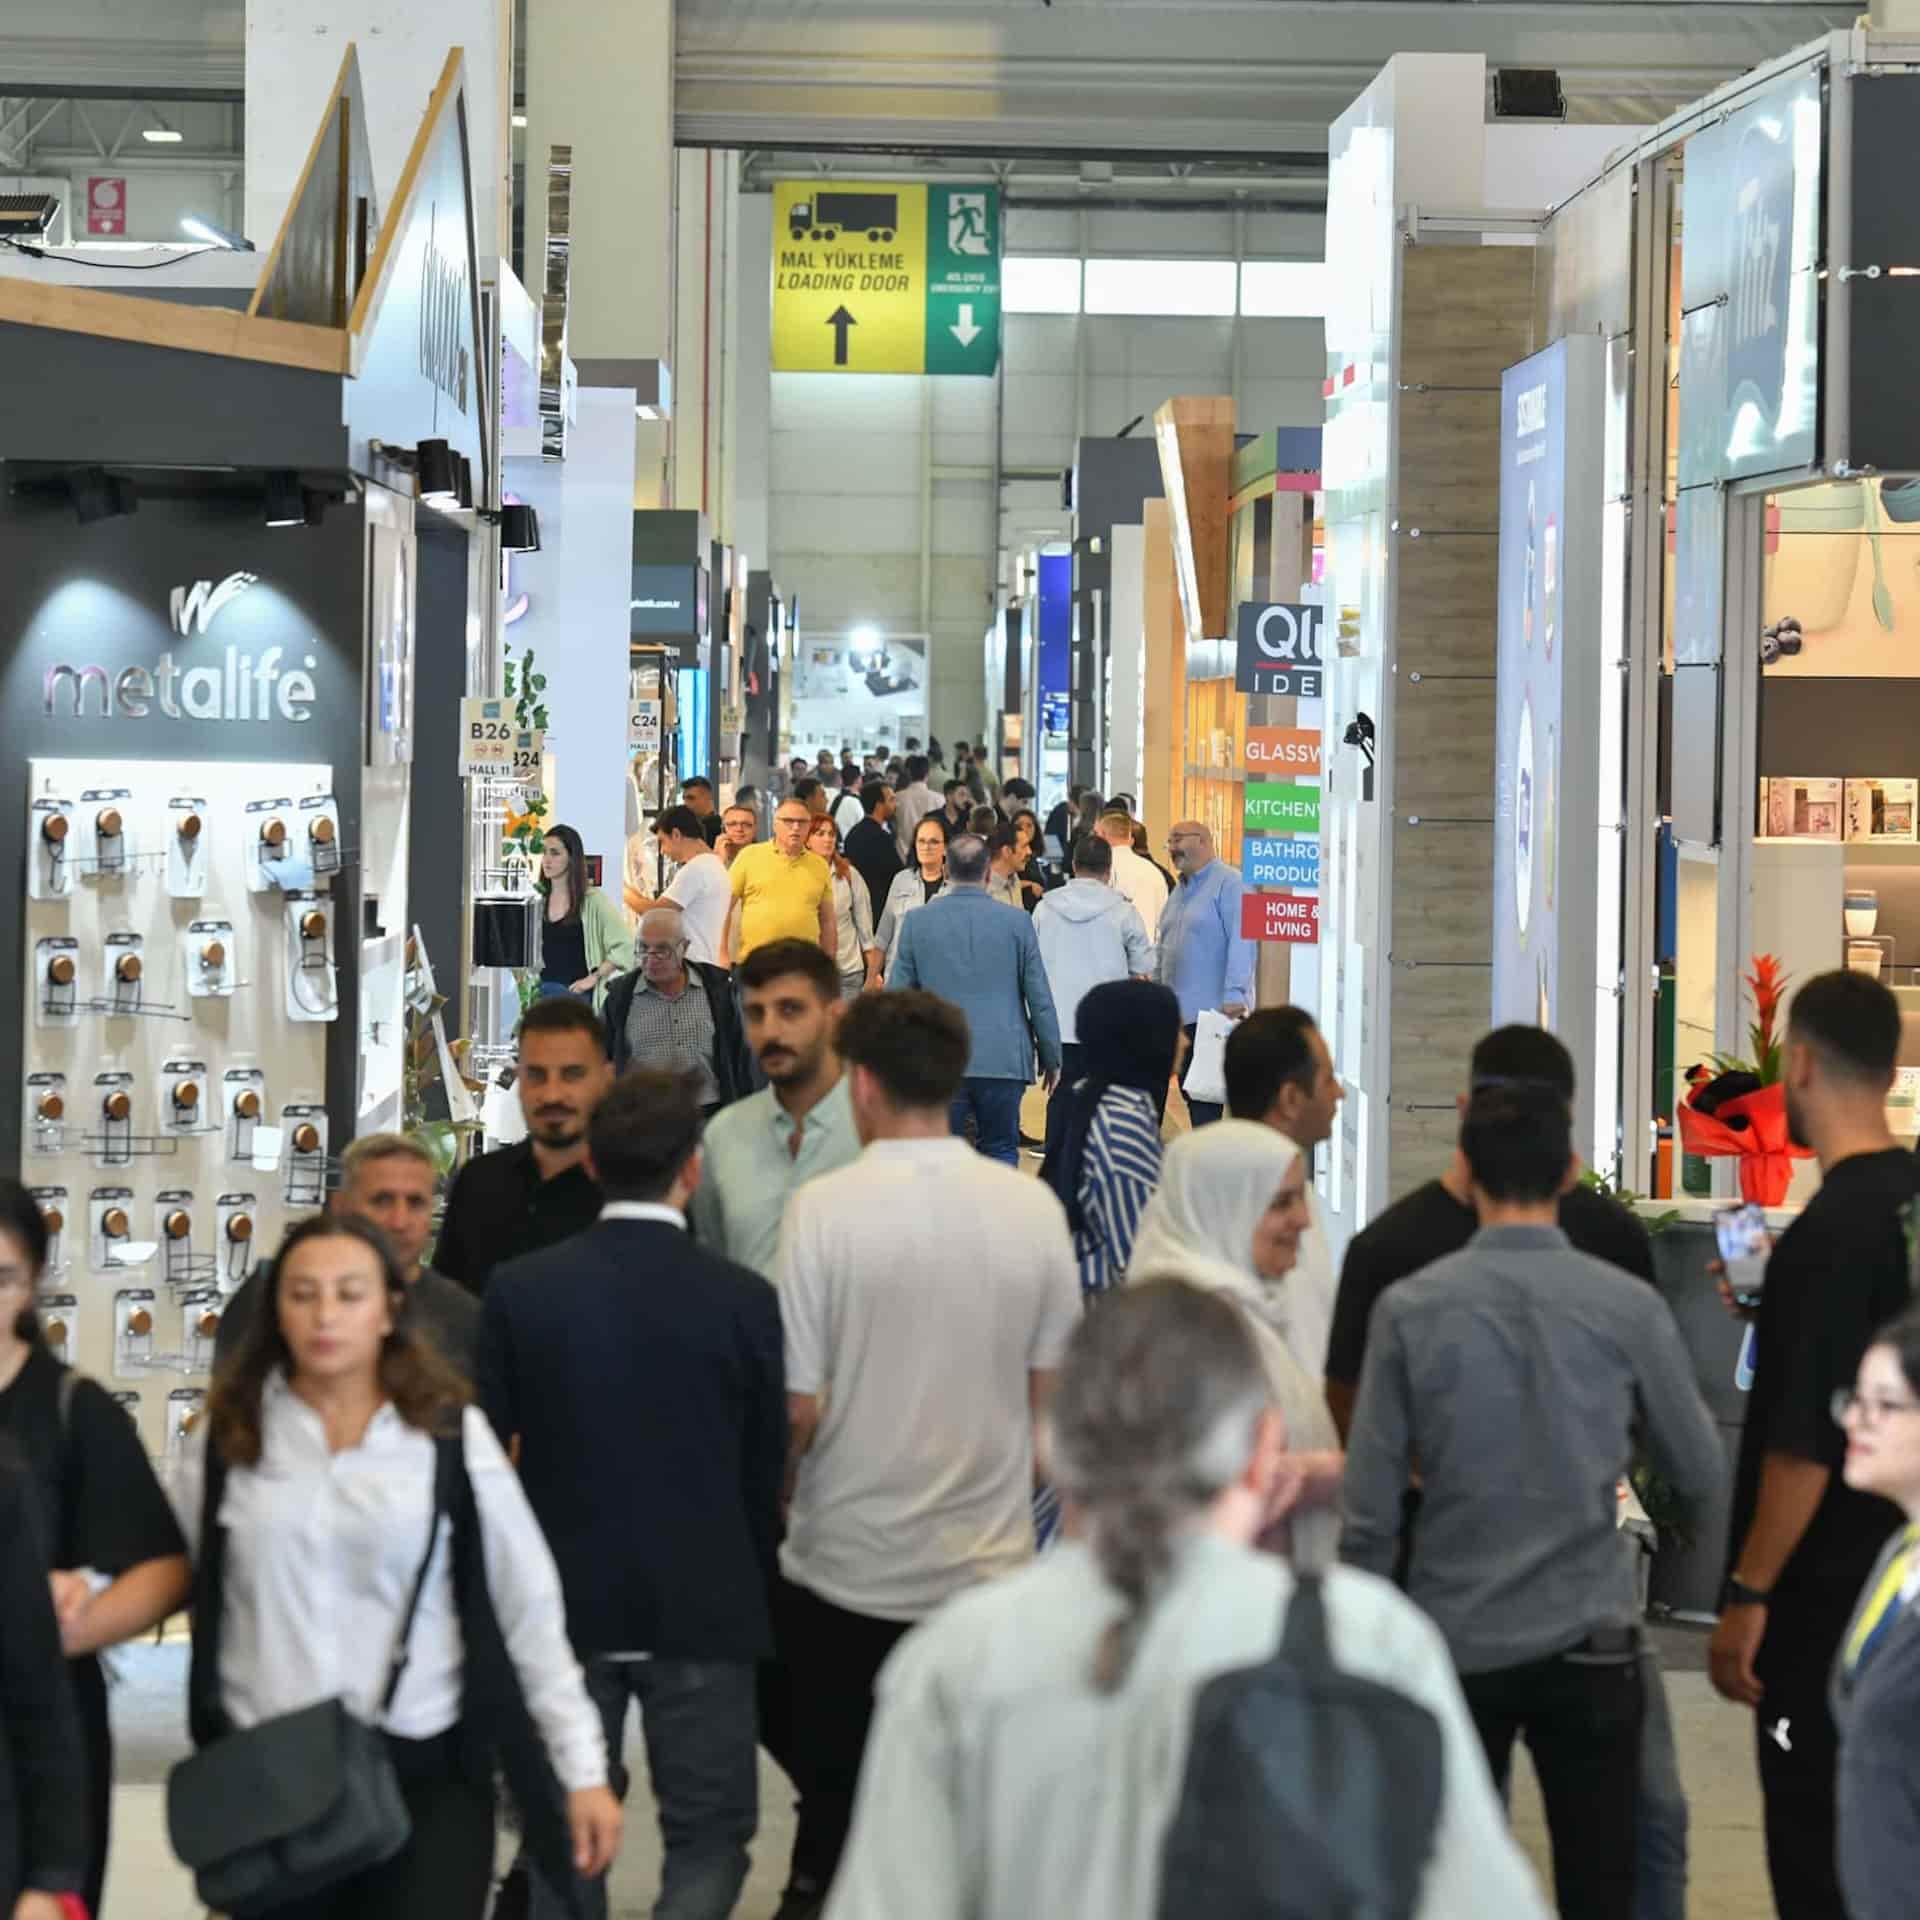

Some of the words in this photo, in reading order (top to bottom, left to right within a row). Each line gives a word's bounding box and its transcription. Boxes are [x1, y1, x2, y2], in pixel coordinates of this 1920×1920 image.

[781, 251, 816, 268] MAL
[824, 248, 904, 270] YÜKLEME
[777, 272, 855, 290] LOADING
[860, 275, 910, 291] DOOR
[42, 645, 317, 723] metalife
[632, 715, 657, 727] C24
[471, 723, 511, 740] B26
[469, 764, 496, 775] HALL
[501, 765, 510, 775] 11
[1245, 799, 1320, 817] KITCHEN
[1252, 841, 1320, 859] BATHRO
[1266, 901, 1308, 918] HOME
[1266, 920, 1312, 937] LIVING
